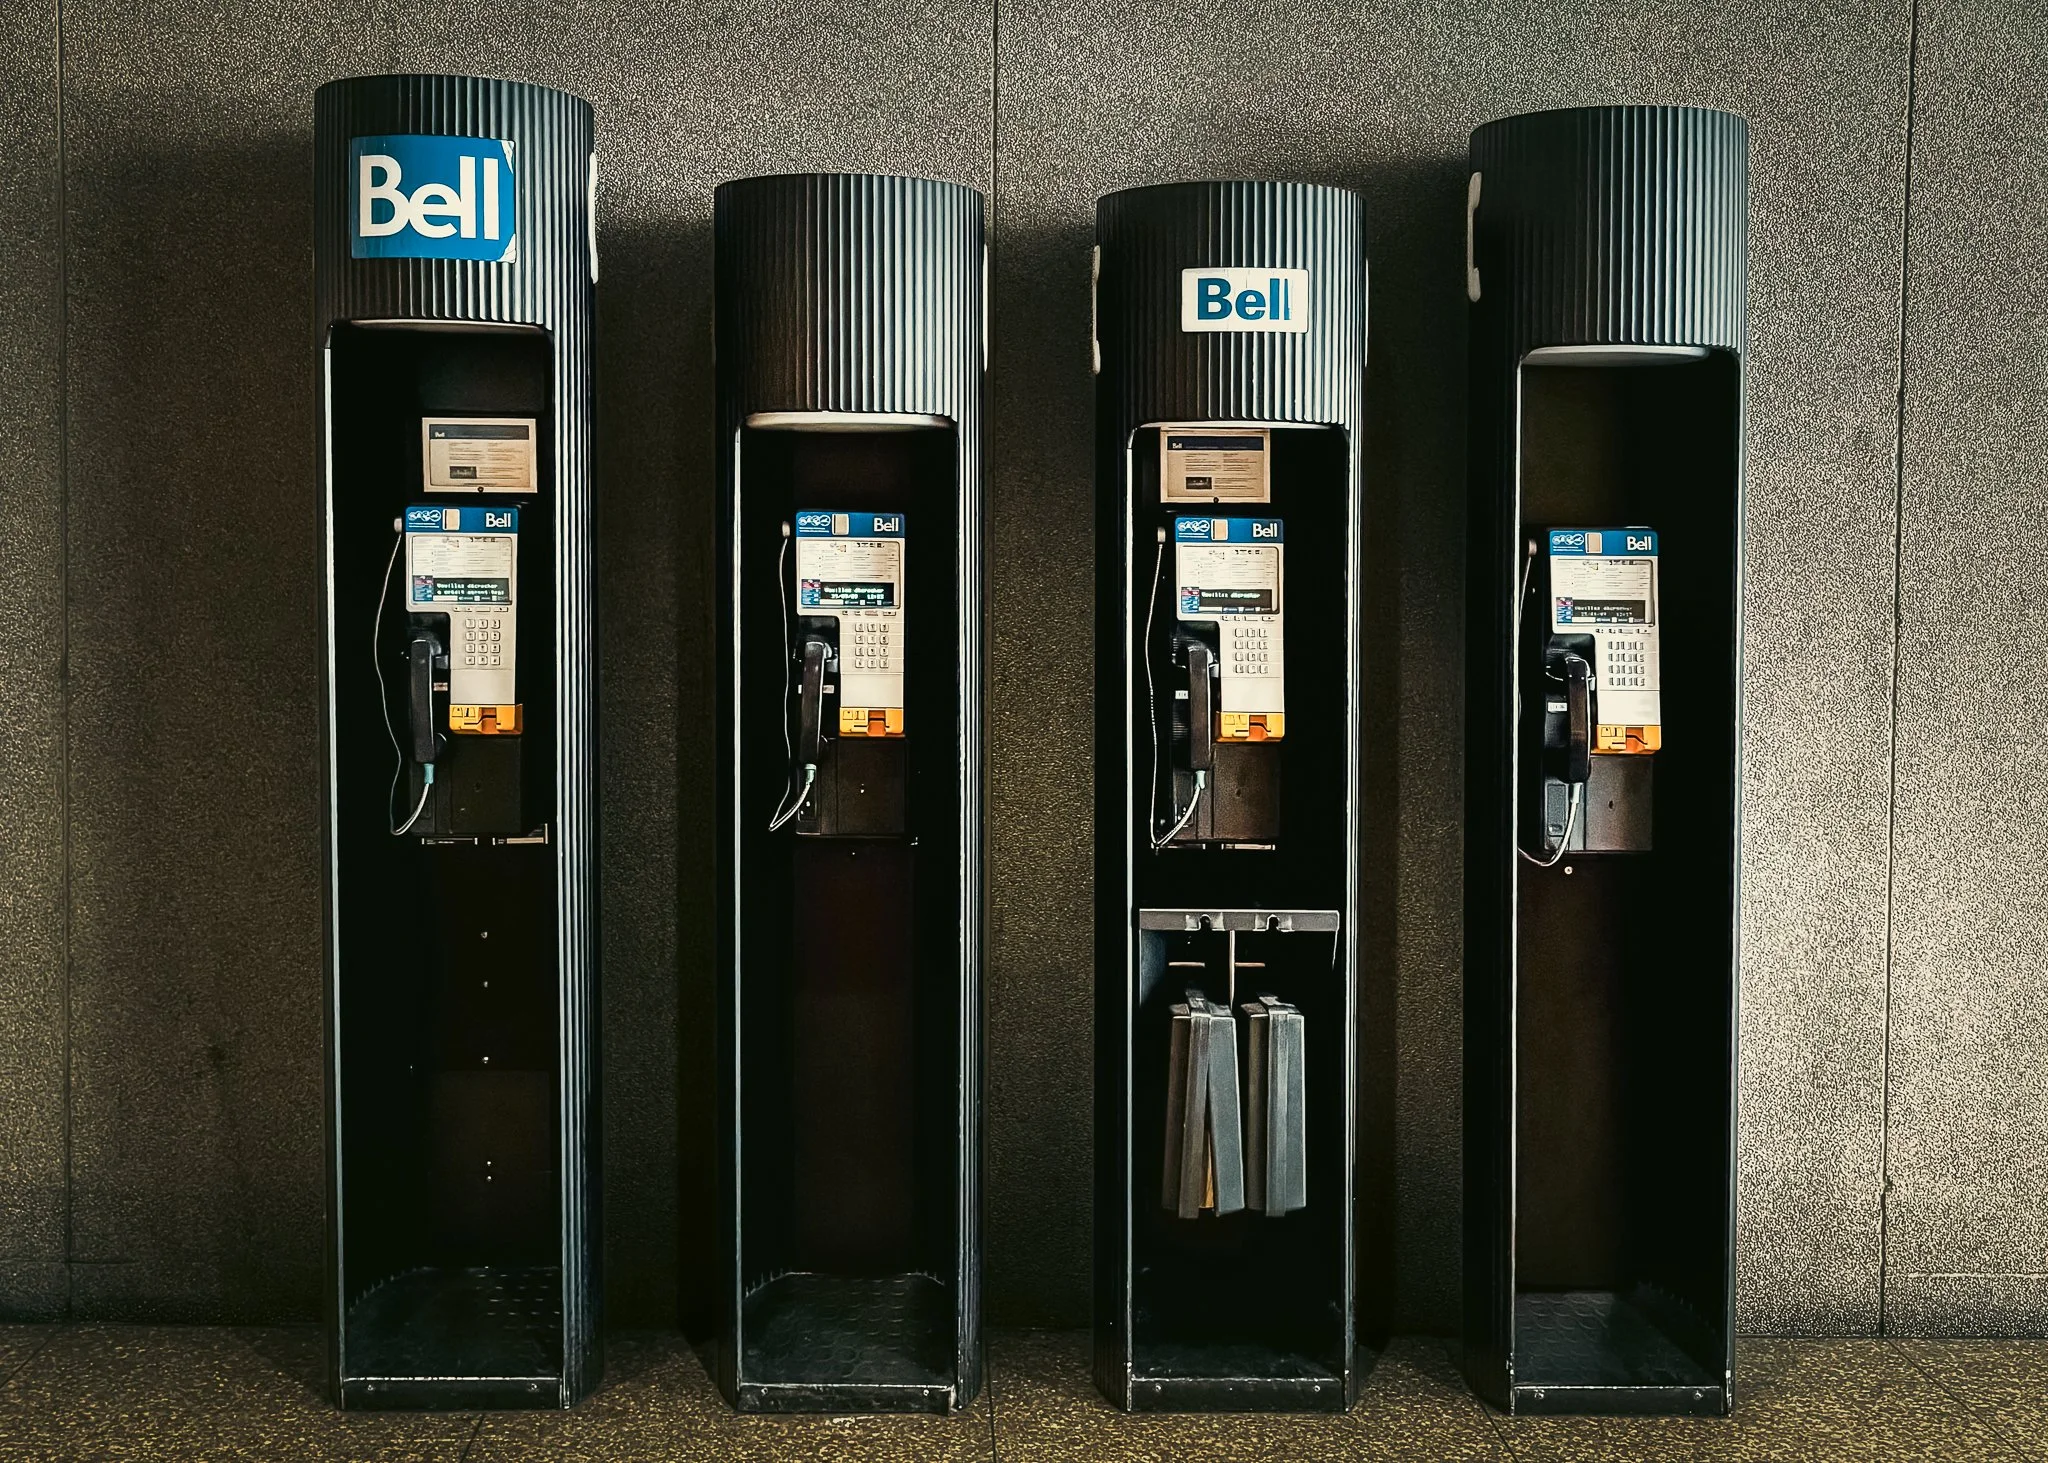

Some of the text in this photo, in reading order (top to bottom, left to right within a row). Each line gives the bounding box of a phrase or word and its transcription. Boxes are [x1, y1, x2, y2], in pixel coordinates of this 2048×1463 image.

[359, 154, 500, 241] Bell
[1197, 277, 1292, 321] Bell
[485, 512, 512, 528] Bell
[873, 517, 899, 532] Bell
[1252, 522, 1278, 538] Bell
[1626, 536, 1652, 551] Bell
